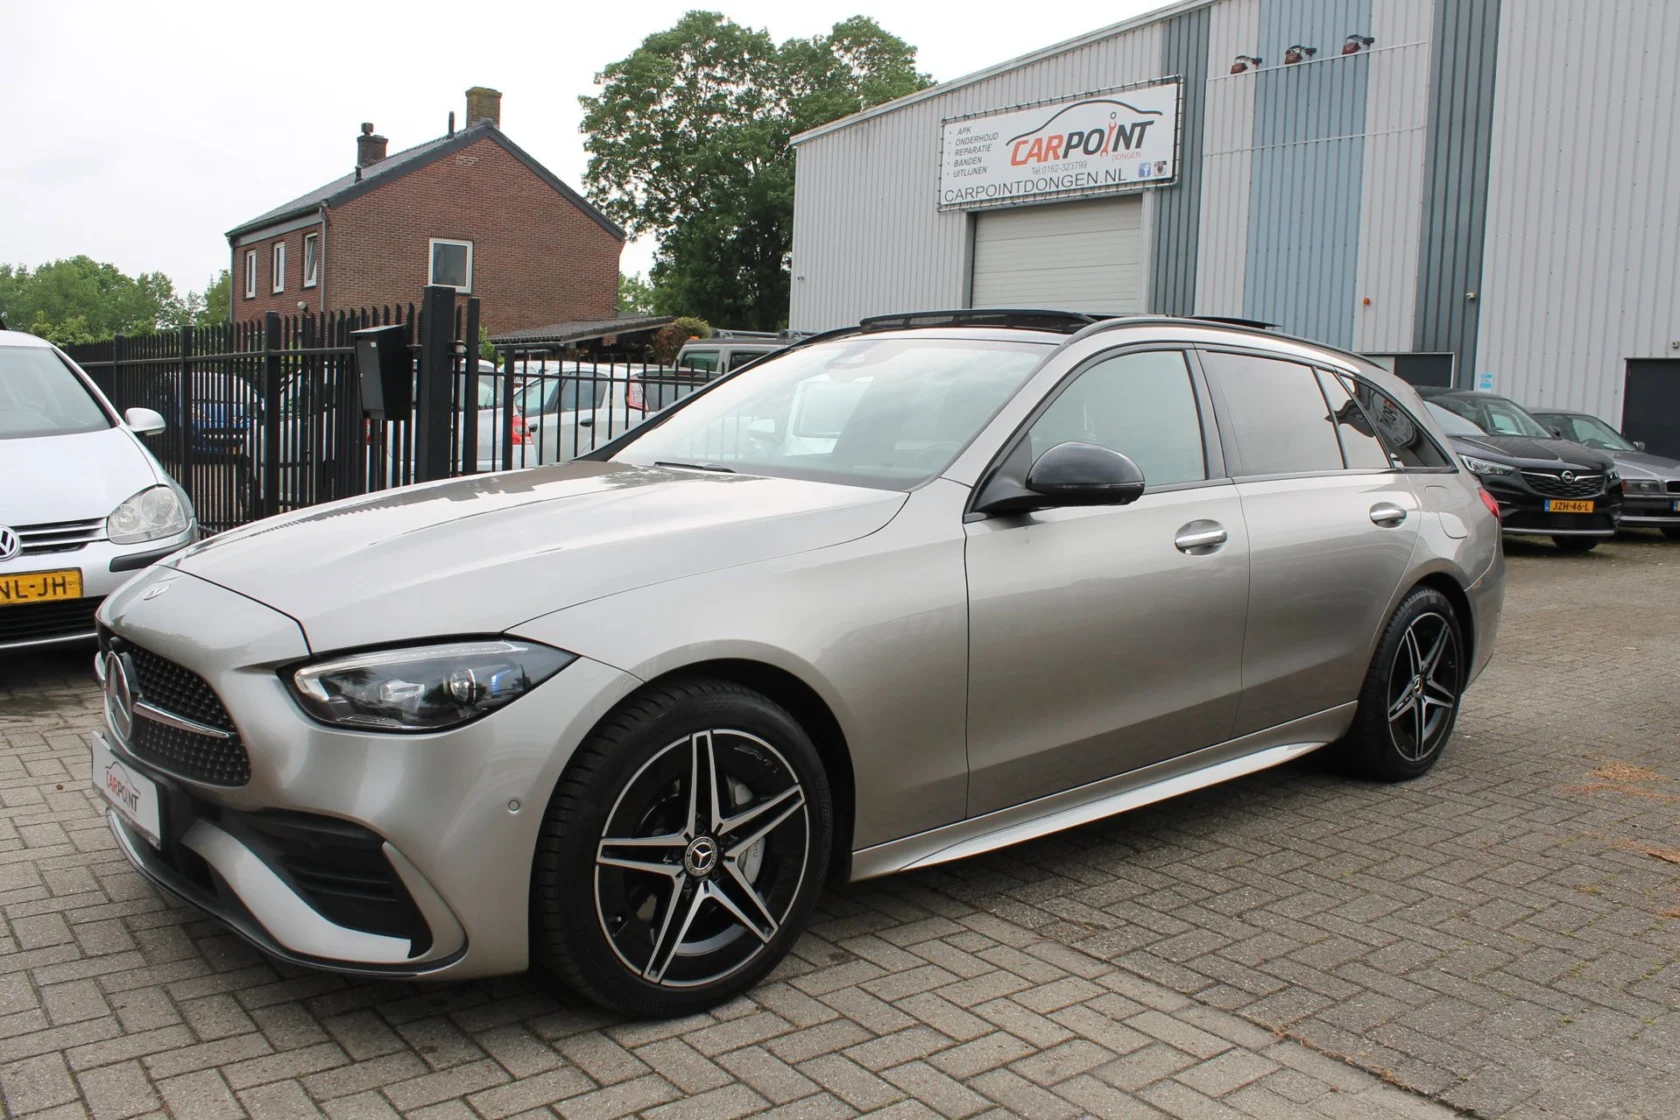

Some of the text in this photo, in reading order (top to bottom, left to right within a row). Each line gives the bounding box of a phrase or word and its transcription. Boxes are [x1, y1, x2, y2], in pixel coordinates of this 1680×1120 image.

[957, 126, 971, 135] APK
[955, 132, 999, 146] ONDERHOUD
[1010, 119, 1155, 167] CARPOINT
[954, 144, 992, 157] REPARATIE
[1111, 151, 1142, 162] DONGEN
[953, 156, 983, 168] BANDEN
[943, 168, 1128, 203] CARPOINTDONGEN.NL
